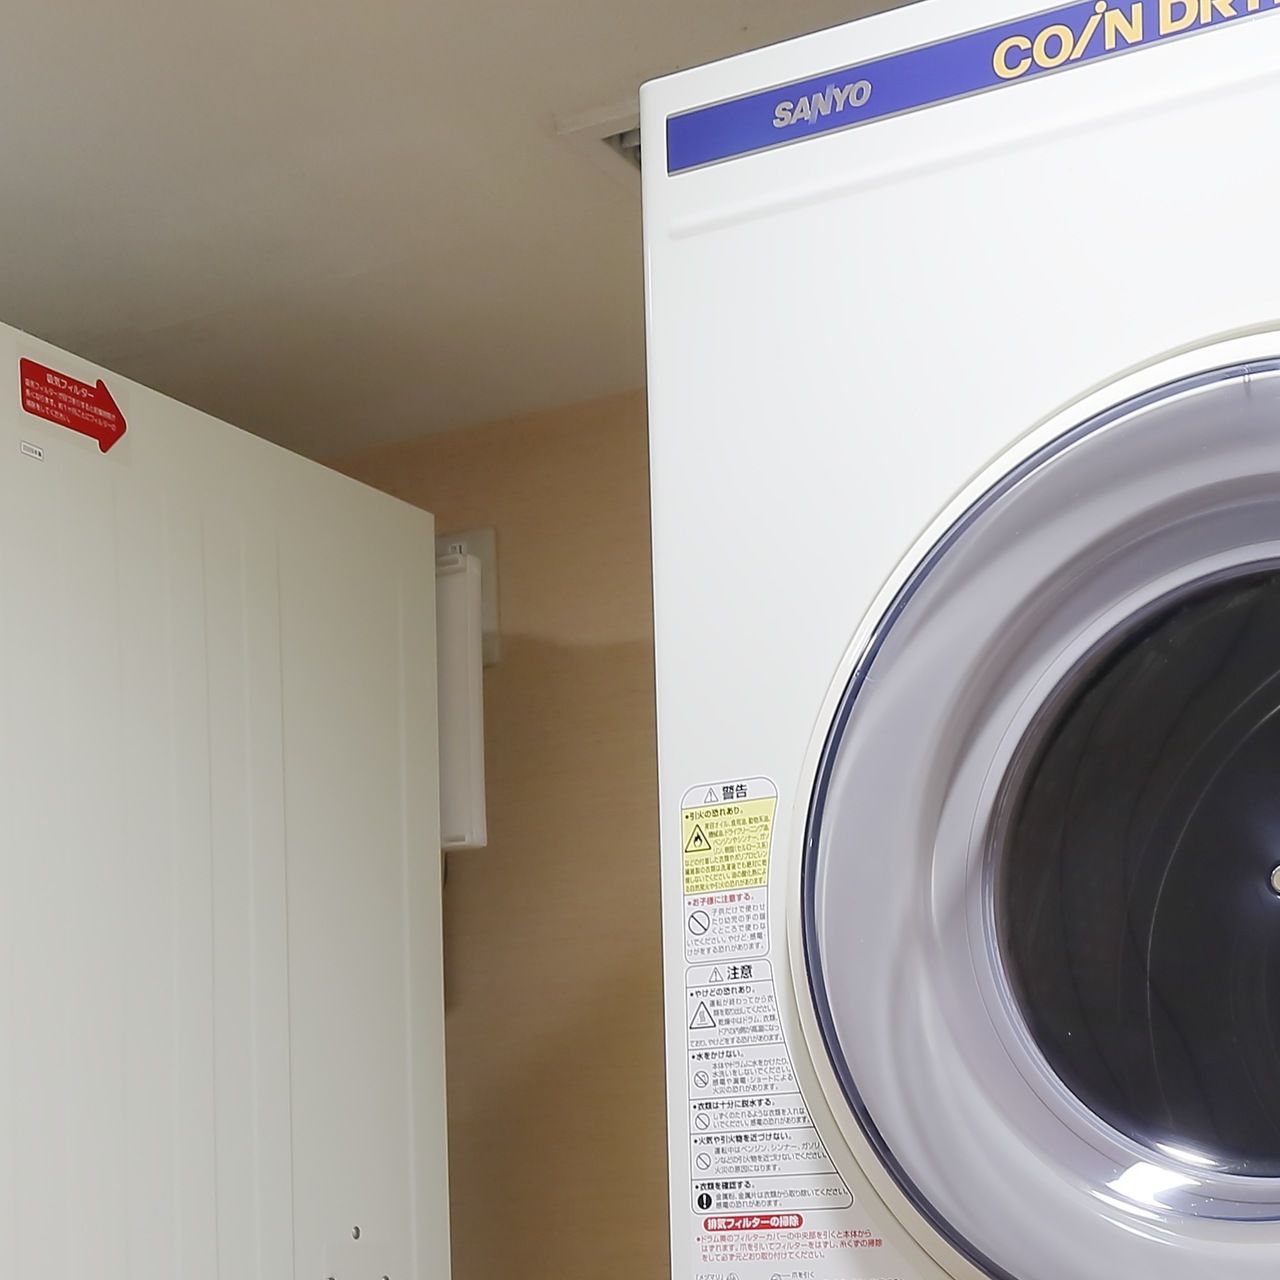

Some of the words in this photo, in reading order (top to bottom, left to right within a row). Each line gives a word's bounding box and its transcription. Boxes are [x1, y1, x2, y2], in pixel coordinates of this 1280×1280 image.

[773, 80, 872, 128] SANYO
[722, 784, 748, 800] 警告
[727, 965, 753, 980] 注意
